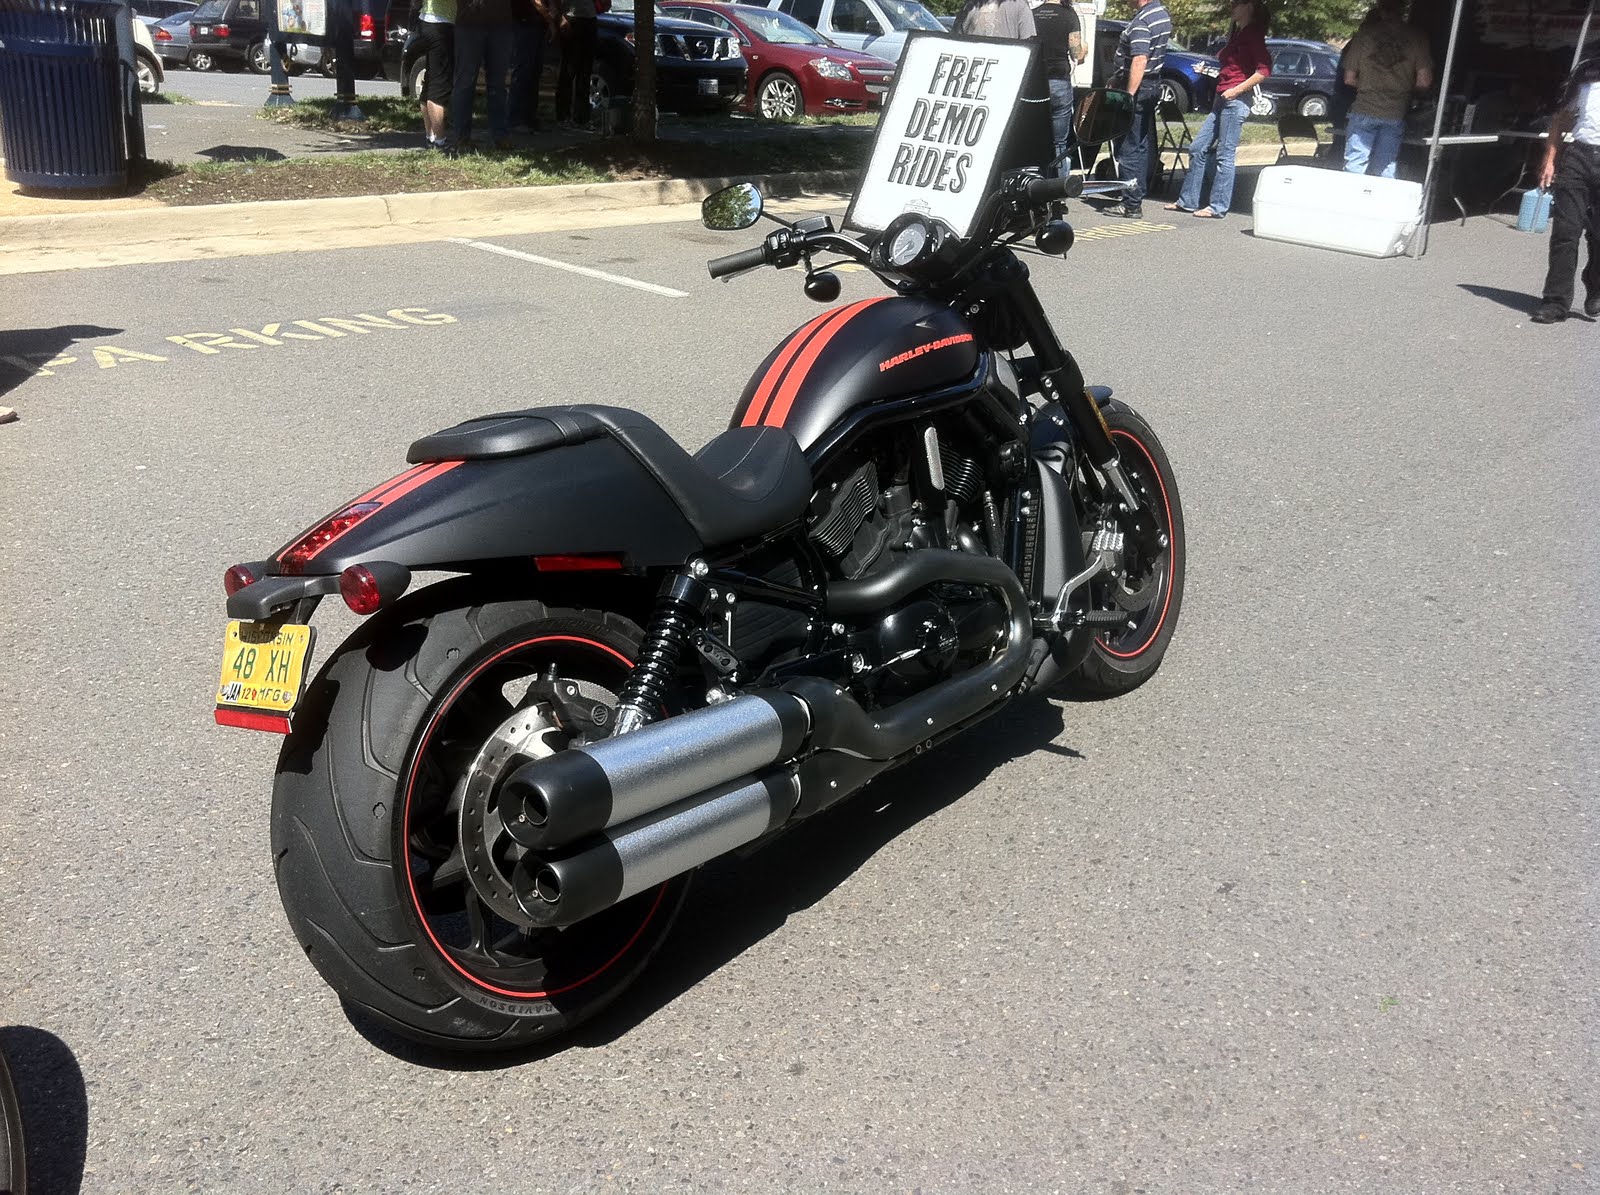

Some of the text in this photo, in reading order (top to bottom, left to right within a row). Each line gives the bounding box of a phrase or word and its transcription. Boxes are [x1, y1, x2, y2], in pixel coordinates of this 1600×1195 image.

[928, 52, 999, 101] FREE
[904, 97, 990, 147] DEMO
[887, 142, 974, 194] RIDES
[2, 307, 458, 377] PARKING
[879, 333, 974, 372] HARLEY-DAVIDSON
[232, 647, 292, 684] 48 XH
[479, 996, 554, 1014] DAVIDSON
